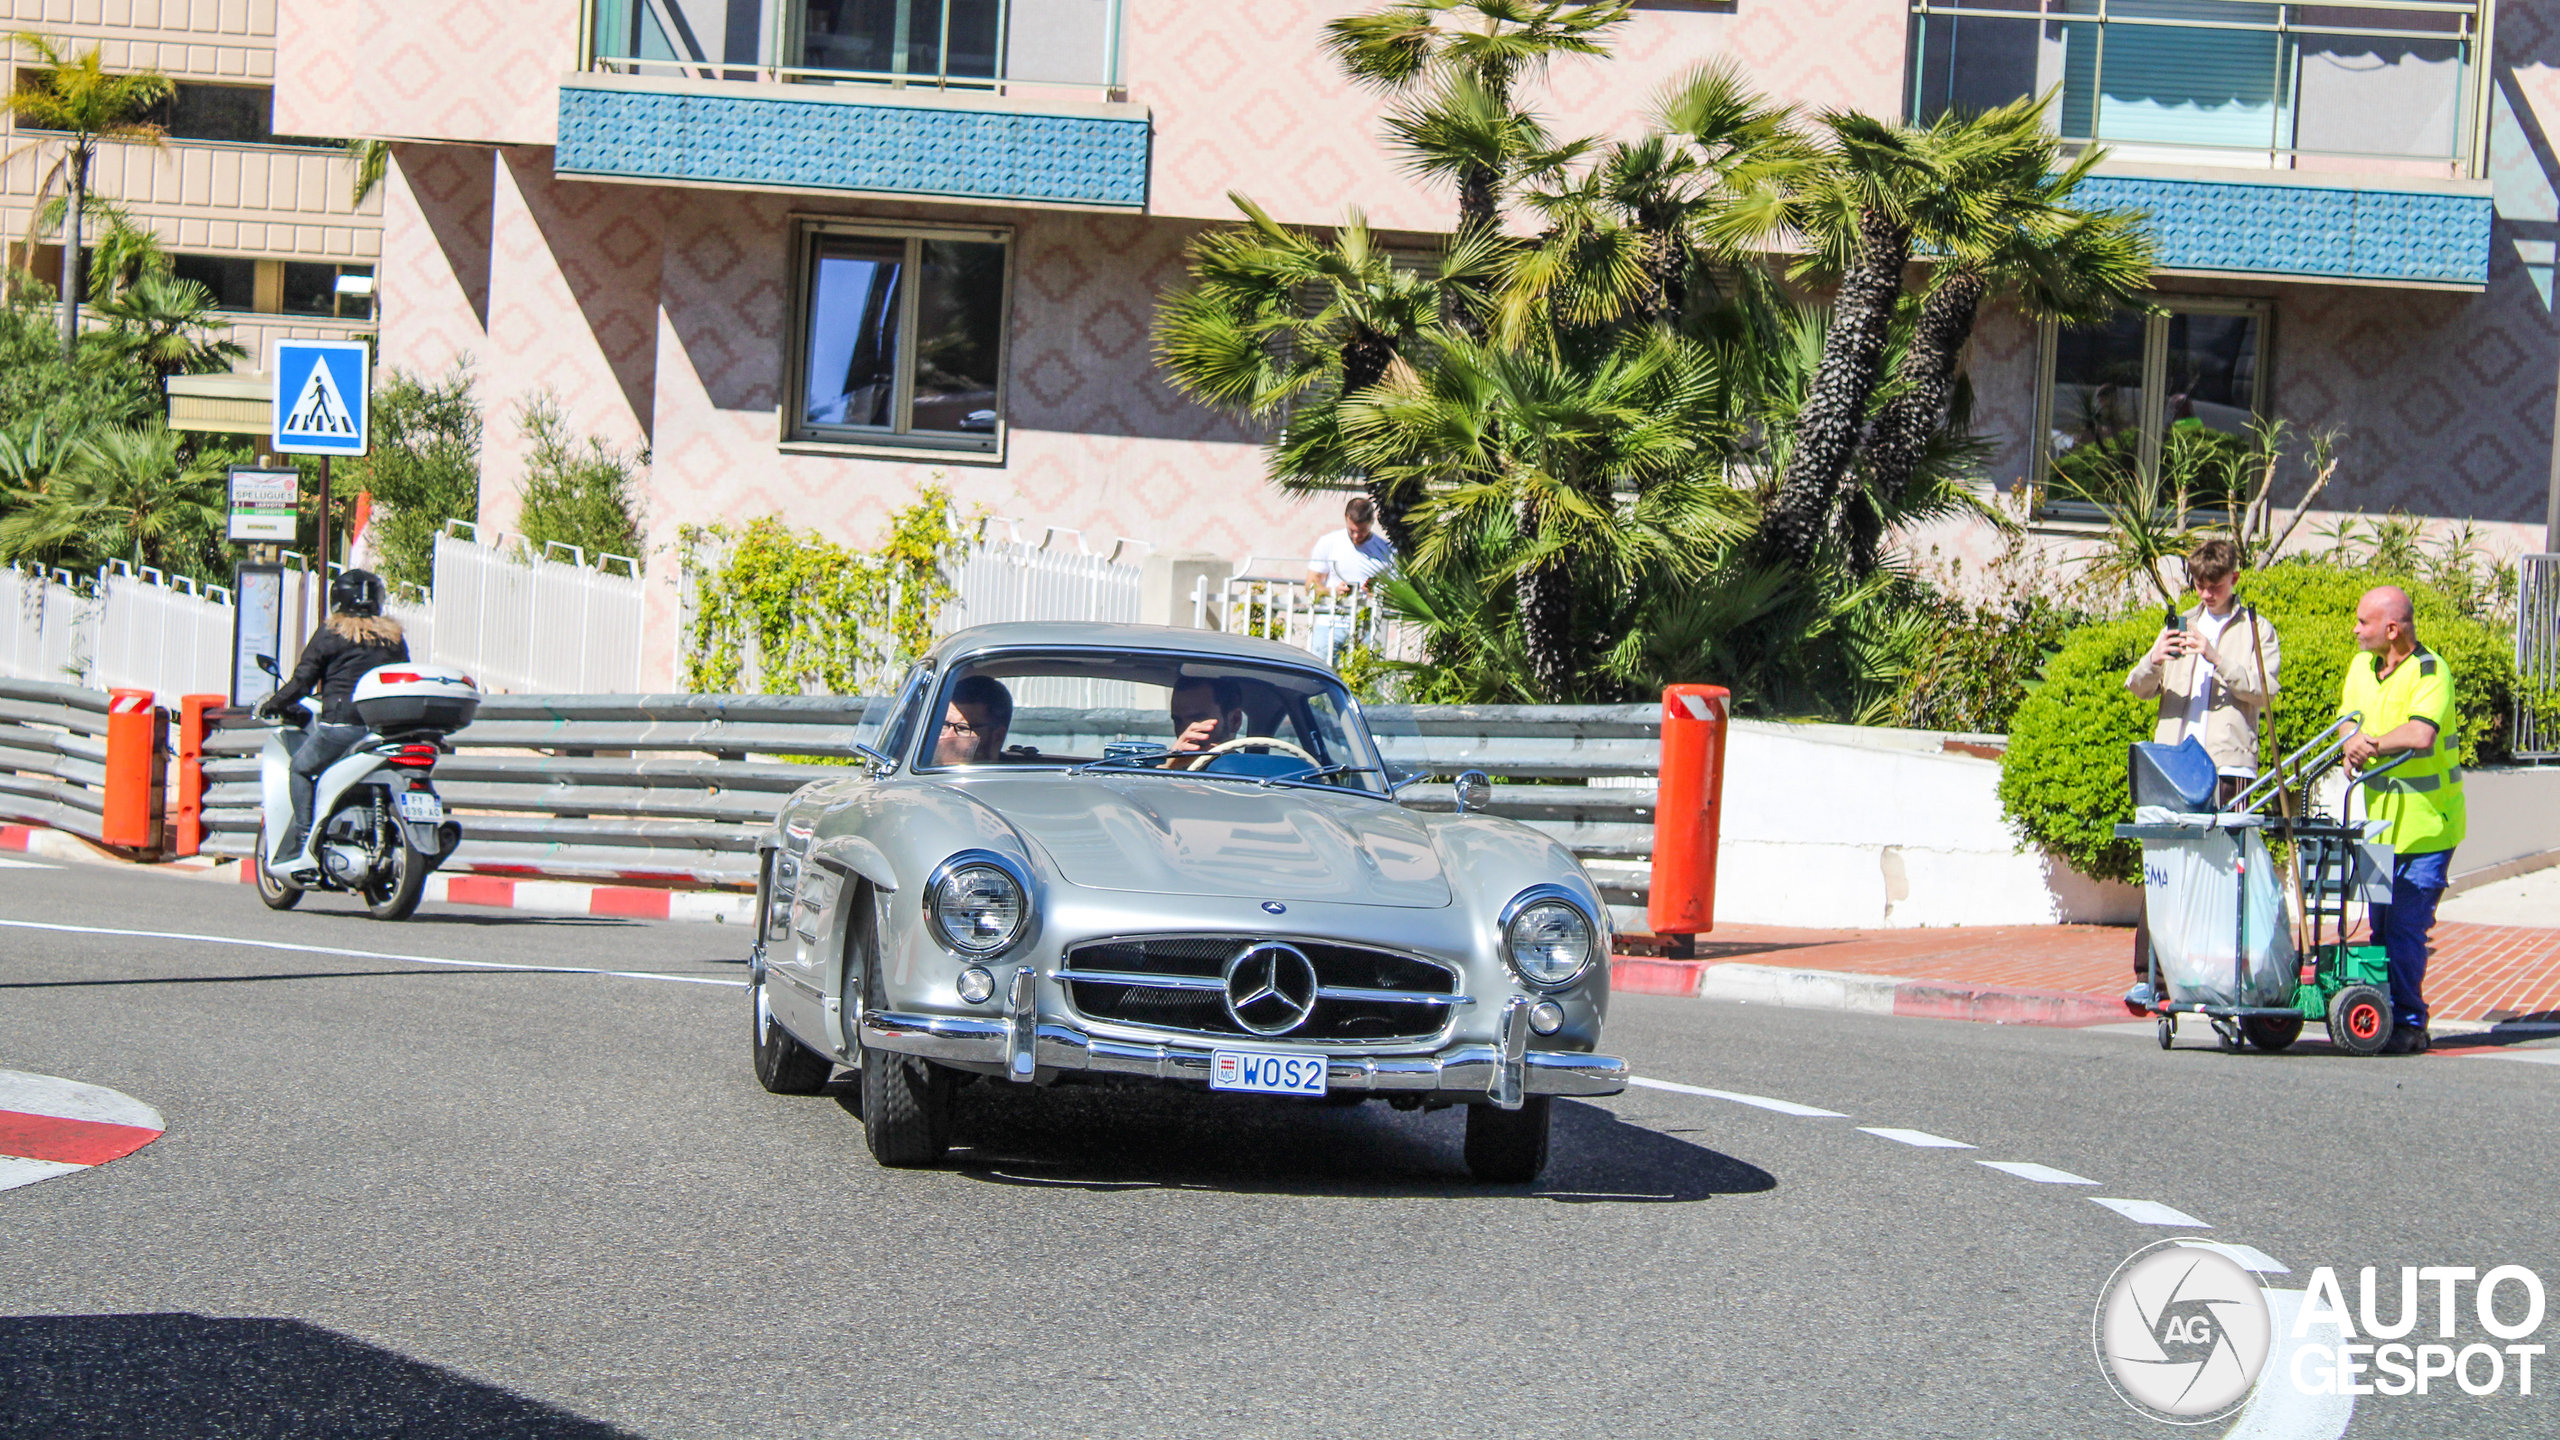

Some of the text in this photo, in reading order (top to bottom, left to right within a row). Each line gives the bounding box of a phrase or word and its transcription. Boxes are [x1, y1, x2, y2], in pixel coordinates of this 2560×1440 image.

[235, 491, 294, 500] SPELUGUES
[1220, 1070, 1234, 1079] MC
[1243, 1056, 1322, 1090] WOS2
